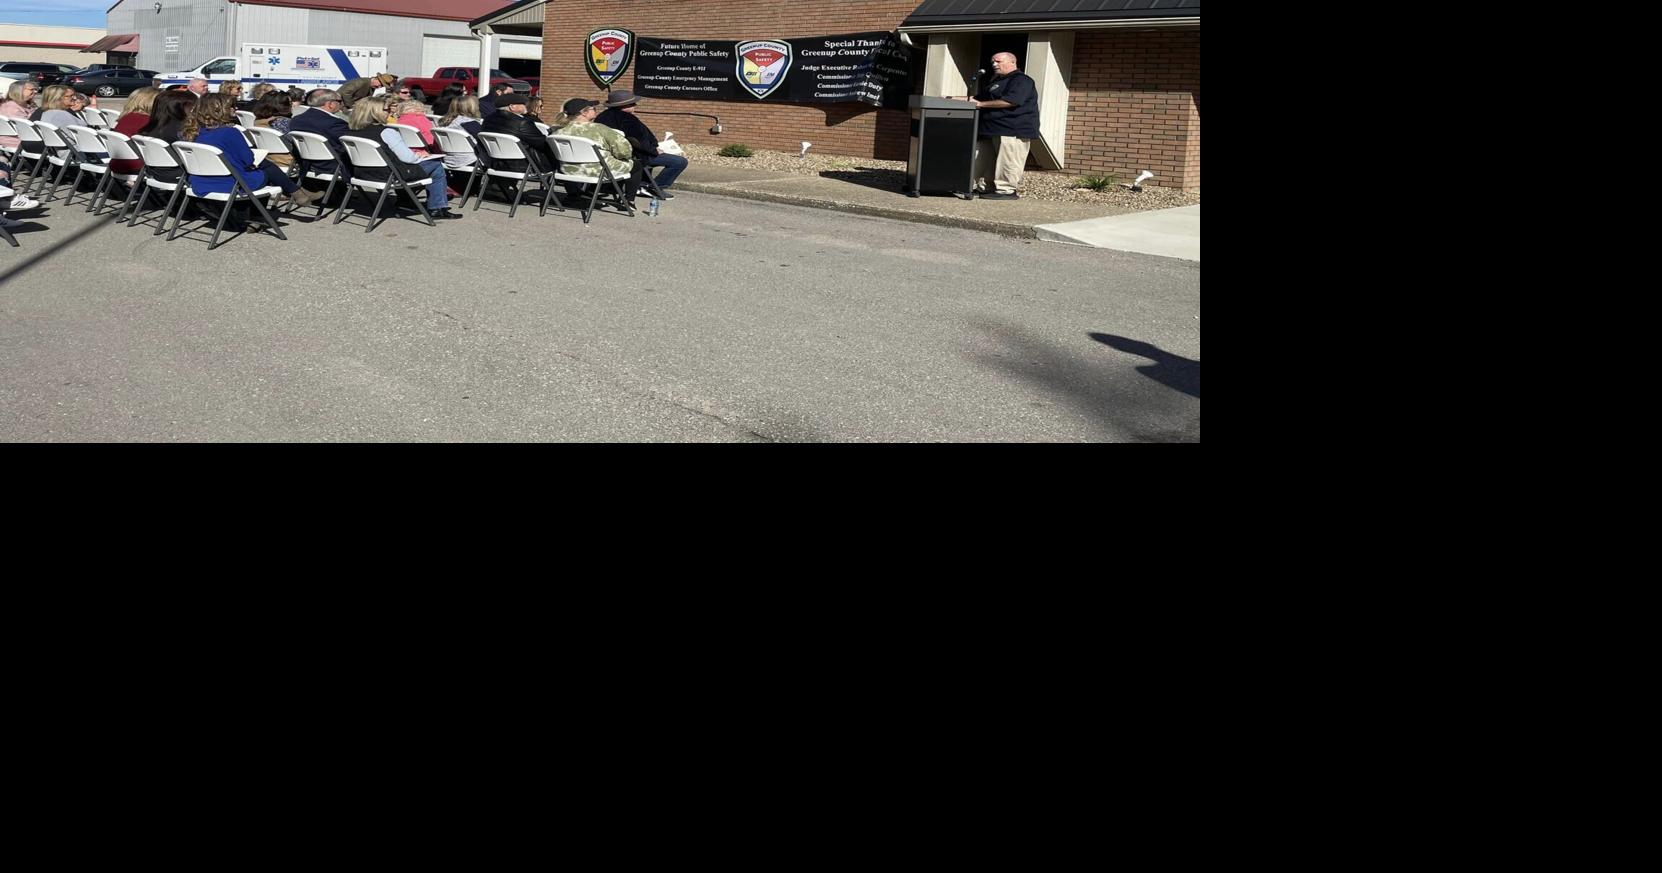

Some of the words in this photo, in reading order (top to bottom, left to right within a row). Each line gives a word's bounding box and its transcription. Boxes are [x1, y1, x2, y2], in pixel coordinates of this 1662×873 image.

[824, 40, 855, 48] Special
[801, 49, 836, 58] Greenup
[838, 48, 870, 57] County
[868, 82, 884, 92] Duty
